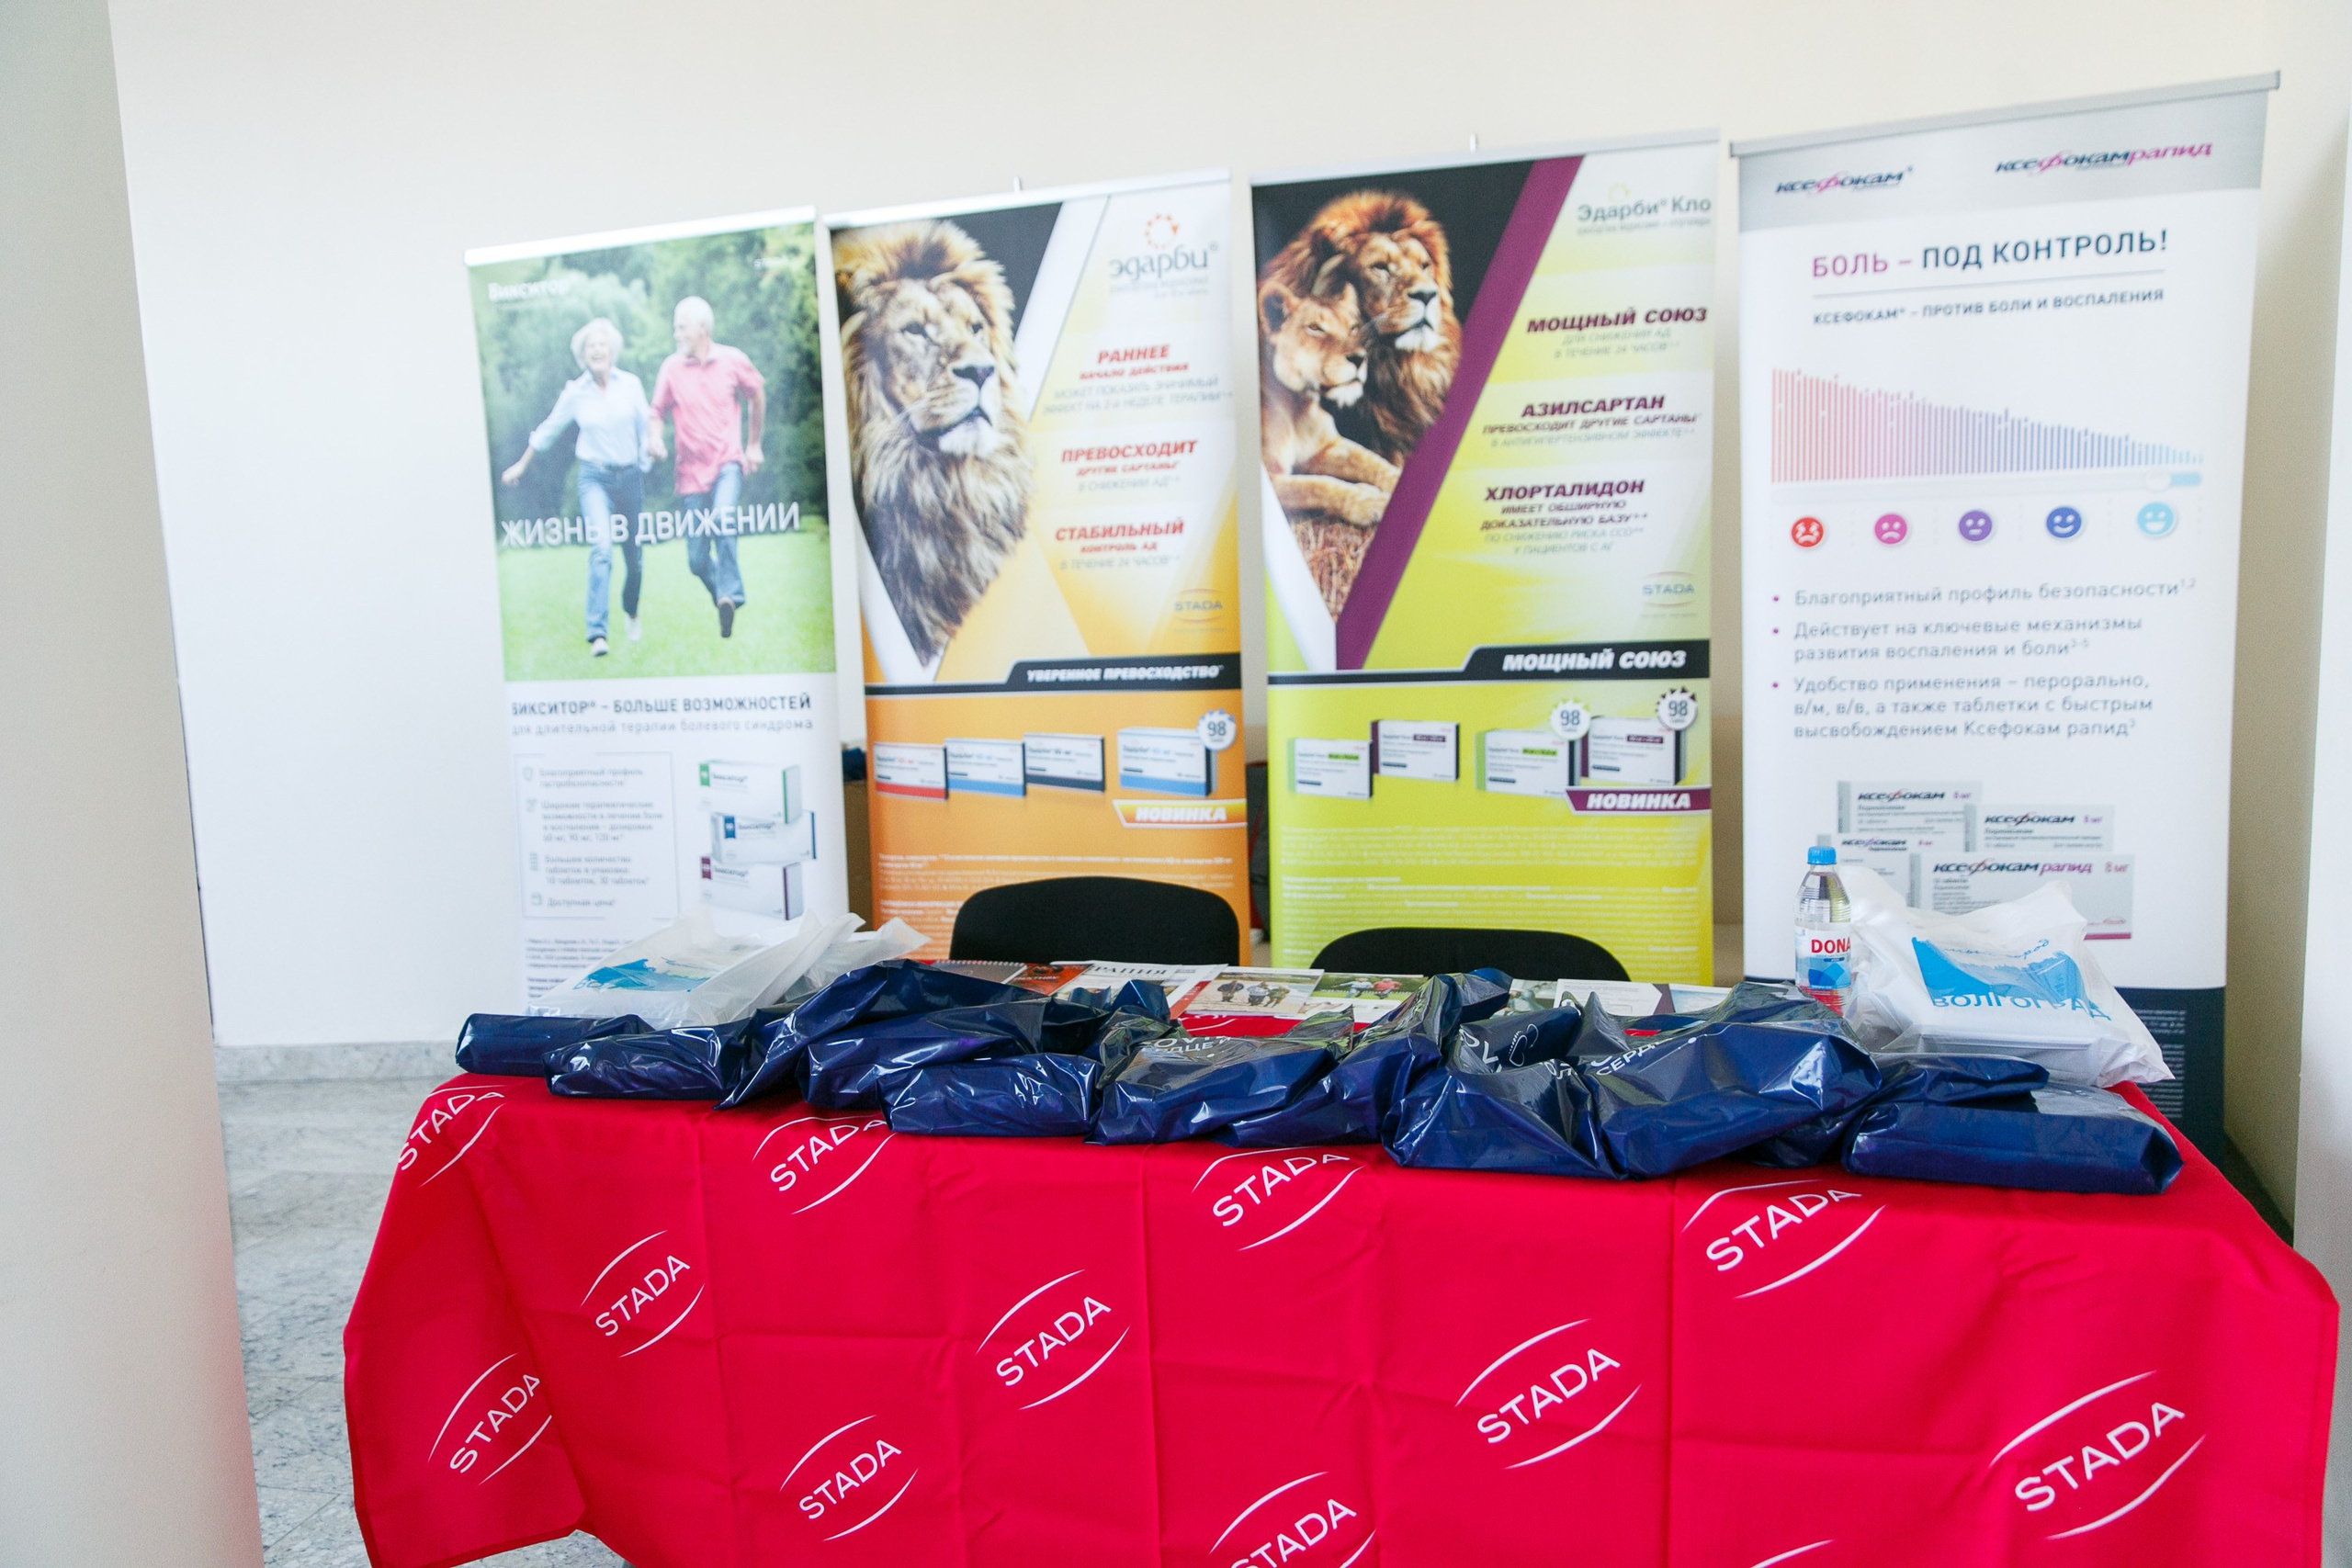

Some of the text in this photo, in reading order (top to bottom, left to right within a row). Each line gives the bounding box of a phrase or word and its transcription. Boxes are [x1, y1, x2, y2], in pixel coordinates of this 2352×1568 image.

[1672, 196, 1712, 213] Кло
[1812, 256, 1889, 278] БОЛЬ
[1922, 244, 1983, 271] ПОД
[1993, 228, 2169, 265] КОНТРОЛЬ!
[1922, 301, 1984, 319] ПРОТИВ
[1989, 299, 2033, 314] БОЛИ
[2038, 297, 2048, 310] И
[2052, 289, 2164, 309] ВОСПАЛЕНИЯ
[1527, 306, 1708, 333] МОЩНЫЙ СОЮЗ
[1098, 344, 1170, 364] РАННЕЕ
[1521, 395, 1667, 418] АЗИЛСАРТАН
[1482, 421, 1576, 434] ПРЕВОСХОДИТ
[1579, 416, 1630, 429] ДРУГИЕ
[1061, 439, 1198, 462] ПРЕВОСХОДИТ
[1485, 479, 1645, 502] ХЛОРТАЛИДОН
[1500, 503, 1544, 514] ИМЕЕТ
[501, 502, 800, 547] ЖИЗНЬ В ДВИЖЕНИИ
[1055, 516, 1185, 542] СТАБИЛЬНЫЙ
[1643, 583, 1695, 595] STADA
[1795, 587, 1943, 607] Благоприятный
[1947, 585, 2032, 606] профиль
[1175, 600, 1224, 612] STADA
[1794, 617, 2143, 640] Действует на ключевые механизмы
[1502, 649, 1687, 673] МОЩНЫЙ СОЮЗ
[1794, 647, 1880, 664] развития
[1885, 644, 1998, 660] воспаления
[2004, 644, 2016, 656] и
[1027, 667, 1102, 682] УВЕРЕННОЕ
[1793, 676, 1879, 694] Удобство
[1884, 677, 2001, 694] применения
[2024, 674, 2150, 692] перорально,
[614, 697, 678, 714] БОЛЬШЕ
[683, 692, 811, 713] ВОЗМОЖНОСТЕЙ
[1668, 700, 1689, 717] 98
[1875, 702, 1886, 714] а
[1893, 700, 1947, 714] также
[1954, 696, 2039, 713] таблетки
[2045, 700, 2055, 712] с
[2062, 695, 2153, 715] быстрым
[744, 717, 814, 733] синдрома
[1207, 721, 1227, 737] 98
[1560, 710, 1580, 727] 98
[1794, 721, 1958, 739] высвобождением
[1964, 720, 2061, 739] Ксефокам
[1587, 794, 1691, 810] НОВИНКА
[1858, 789, 1946, 802] ксефокам
[1135, 807, 1227, 822] НОВИНКА
[1984, 812, 2075, 827] ксефокам
[398, 1091, 504, 1171] STADA
[770, 1118, 888, 1191] STADA
[1212, 1153, 1351, 1227] STADA
[1706, 1188, 1862, 1272] STADA
[594, 1255, 690, 1337] STADA
[996, 1295, 1112, 1387] STADA
[1476, 1348, 1621, 1445] STADA
[448, 1373, 540, 1474] STADA
[2015, 1401, 2186, 1512] STADA
[799, 1438, 902, 1520] STADA
